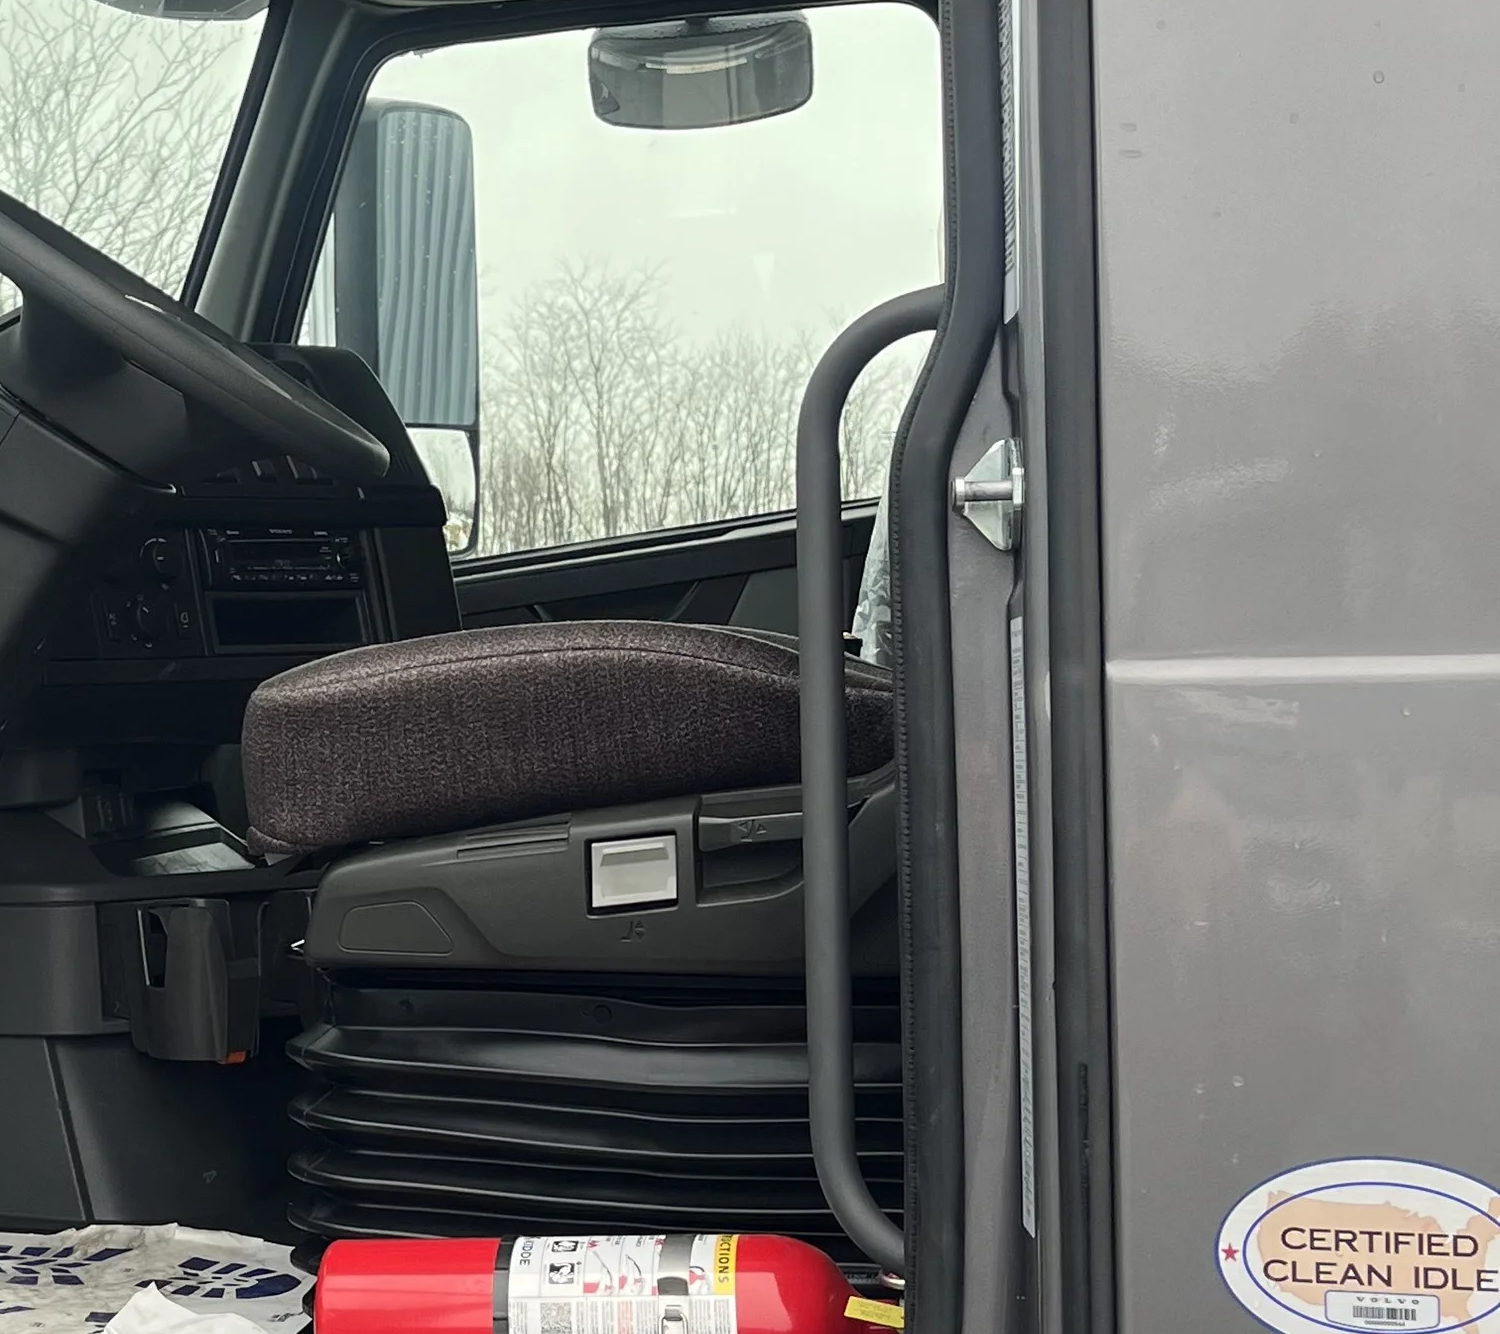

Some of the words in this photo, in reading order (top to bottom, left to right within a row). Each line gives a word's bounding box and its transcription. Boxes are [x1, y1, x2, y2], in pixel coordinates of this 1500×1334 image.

[1280, 1227, 1479, 1257] CERTIFIED
[1263, 1259, 1392, 1288] CLEAN
[1414, 1266, 1499, 1292] IDLE
[1356, 1296, 1420, 1305] VOLVO
